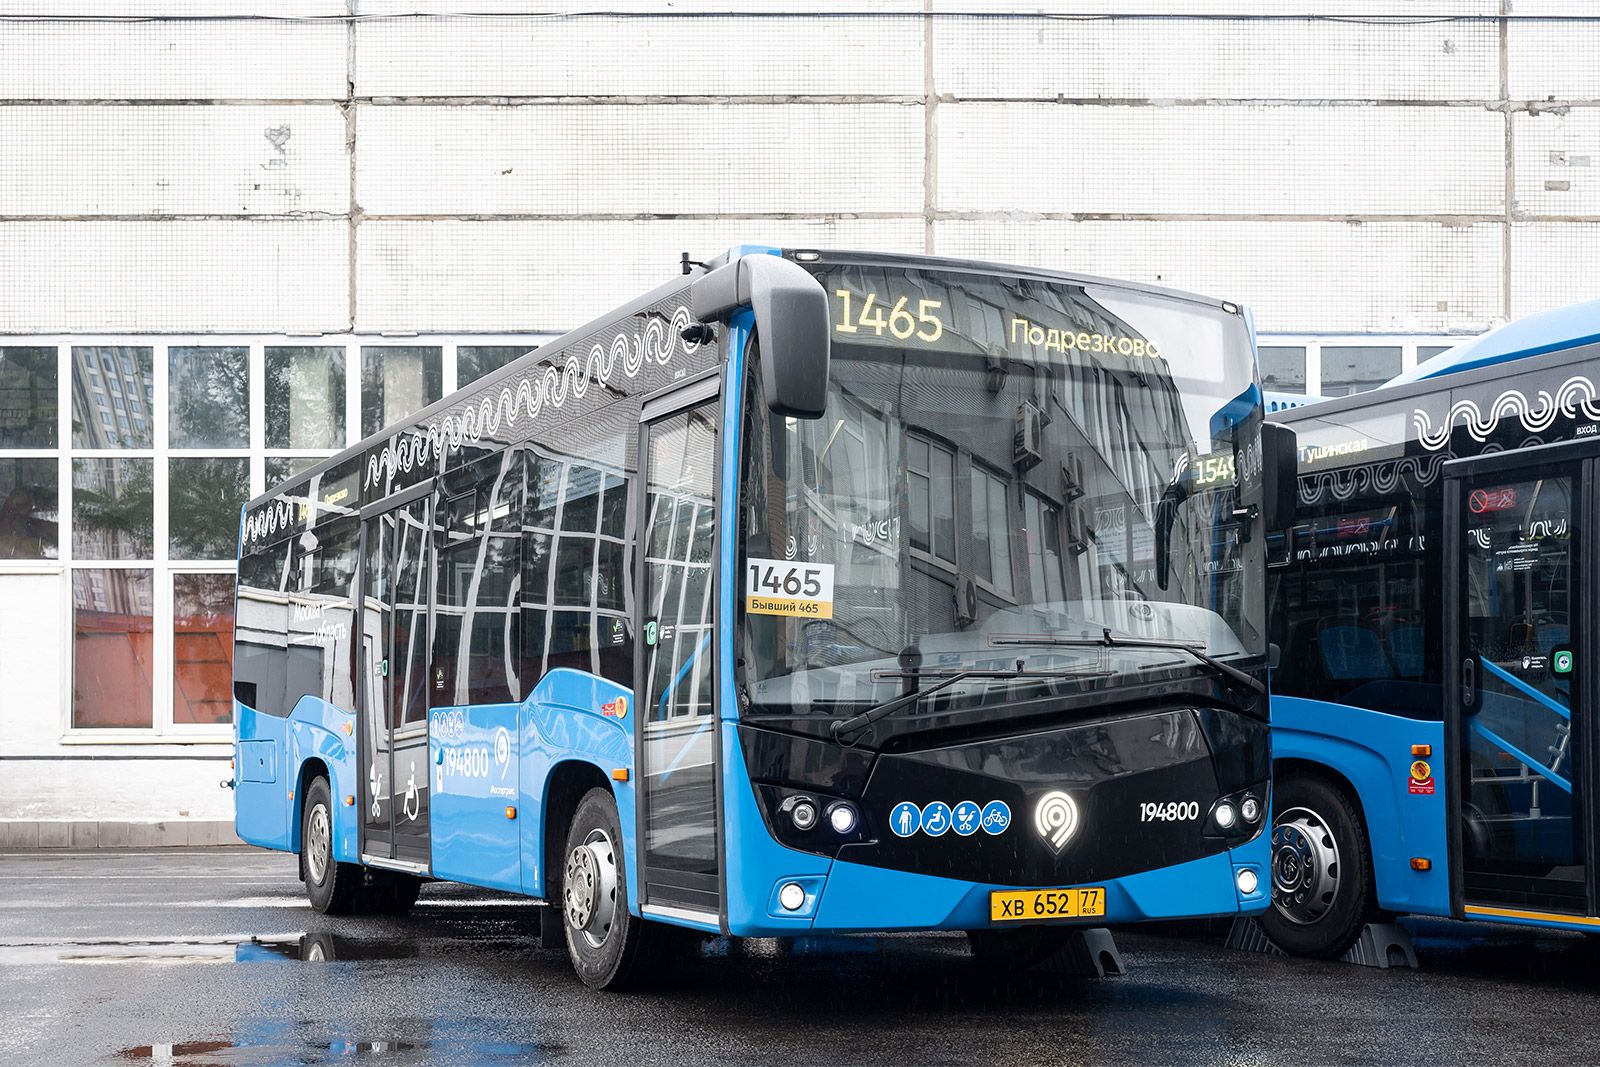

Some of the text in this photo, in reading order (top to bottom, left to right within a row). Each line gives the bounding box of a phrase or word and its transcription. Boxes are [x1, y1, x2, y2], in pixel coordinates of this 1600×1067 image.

[836, 290, 942, 342] 1465
[1011, 318, 1161, 358] Подрезково
[1576, 425, 1597, 435] ВХОД
[1298, 439, 1368, 463] Тушинская
[750, 565, 821, 597] 1465
[752, 599, 818, 613] Бывший 465
[445, 747, 489, 778] 194800
[1140, 801, 1199, 822] 194800
[1034, 893, 1069, 915] 652
[1080, 891, 1098, 907] 77
